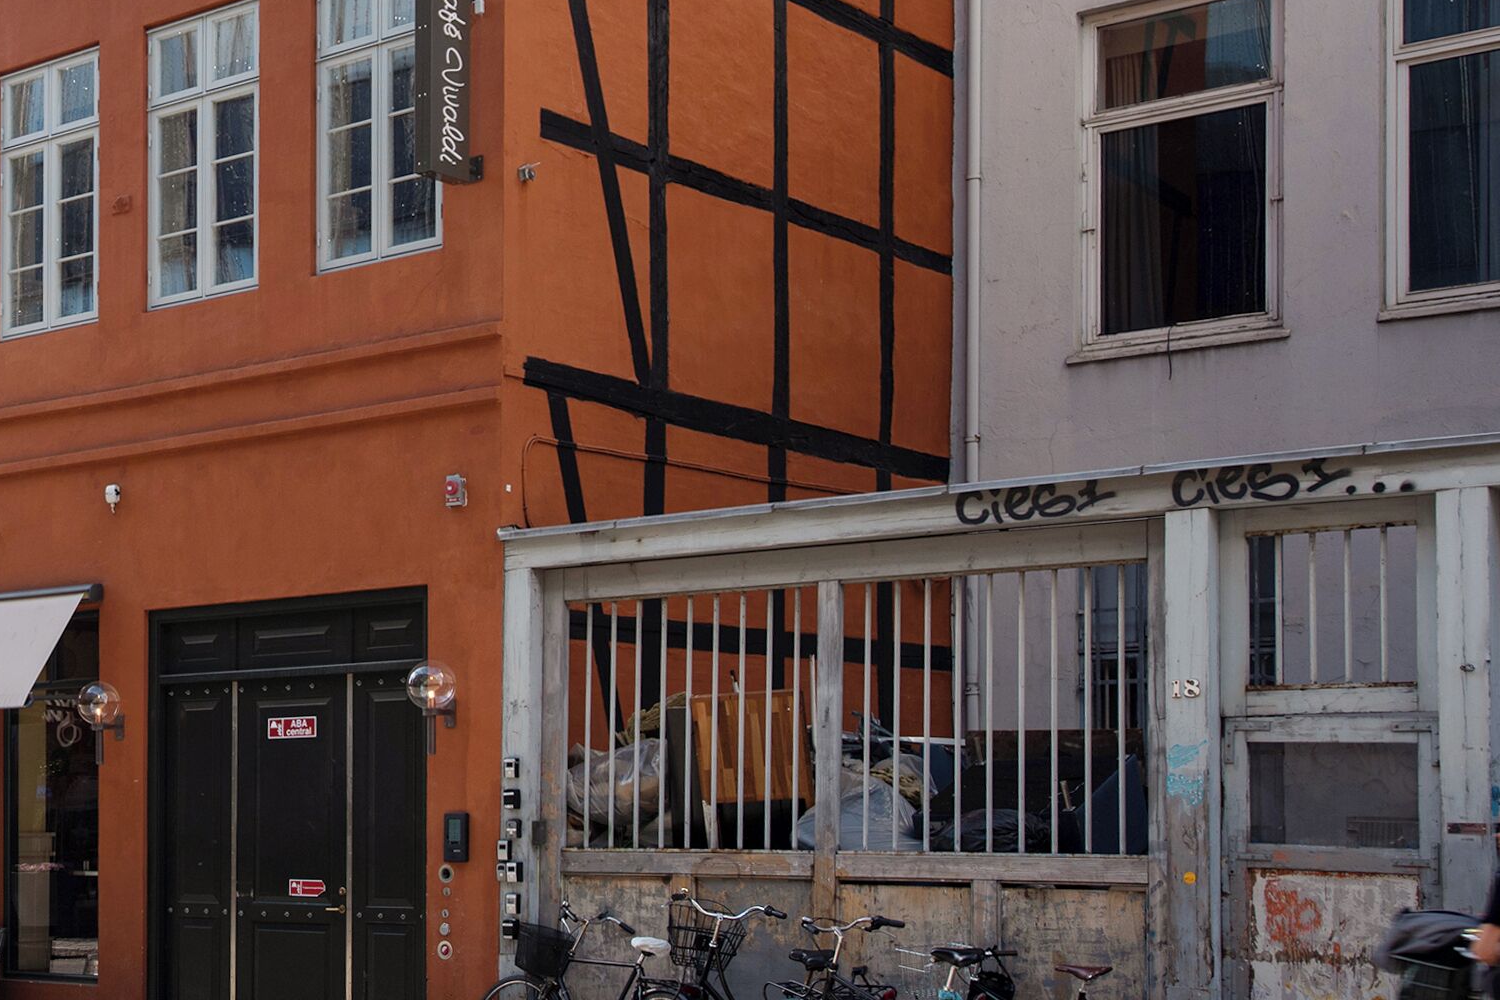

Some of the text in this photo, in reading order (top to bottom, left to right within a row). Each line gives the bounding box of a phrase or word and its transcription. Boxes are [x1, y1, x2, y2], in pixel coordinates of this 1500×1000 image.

[440, 47, 465, 165] Vivaldi
[1172, 679, 1200, 698] 18
[291, 719, 307, 728] ABA
[286, 726, 312, 736] central
